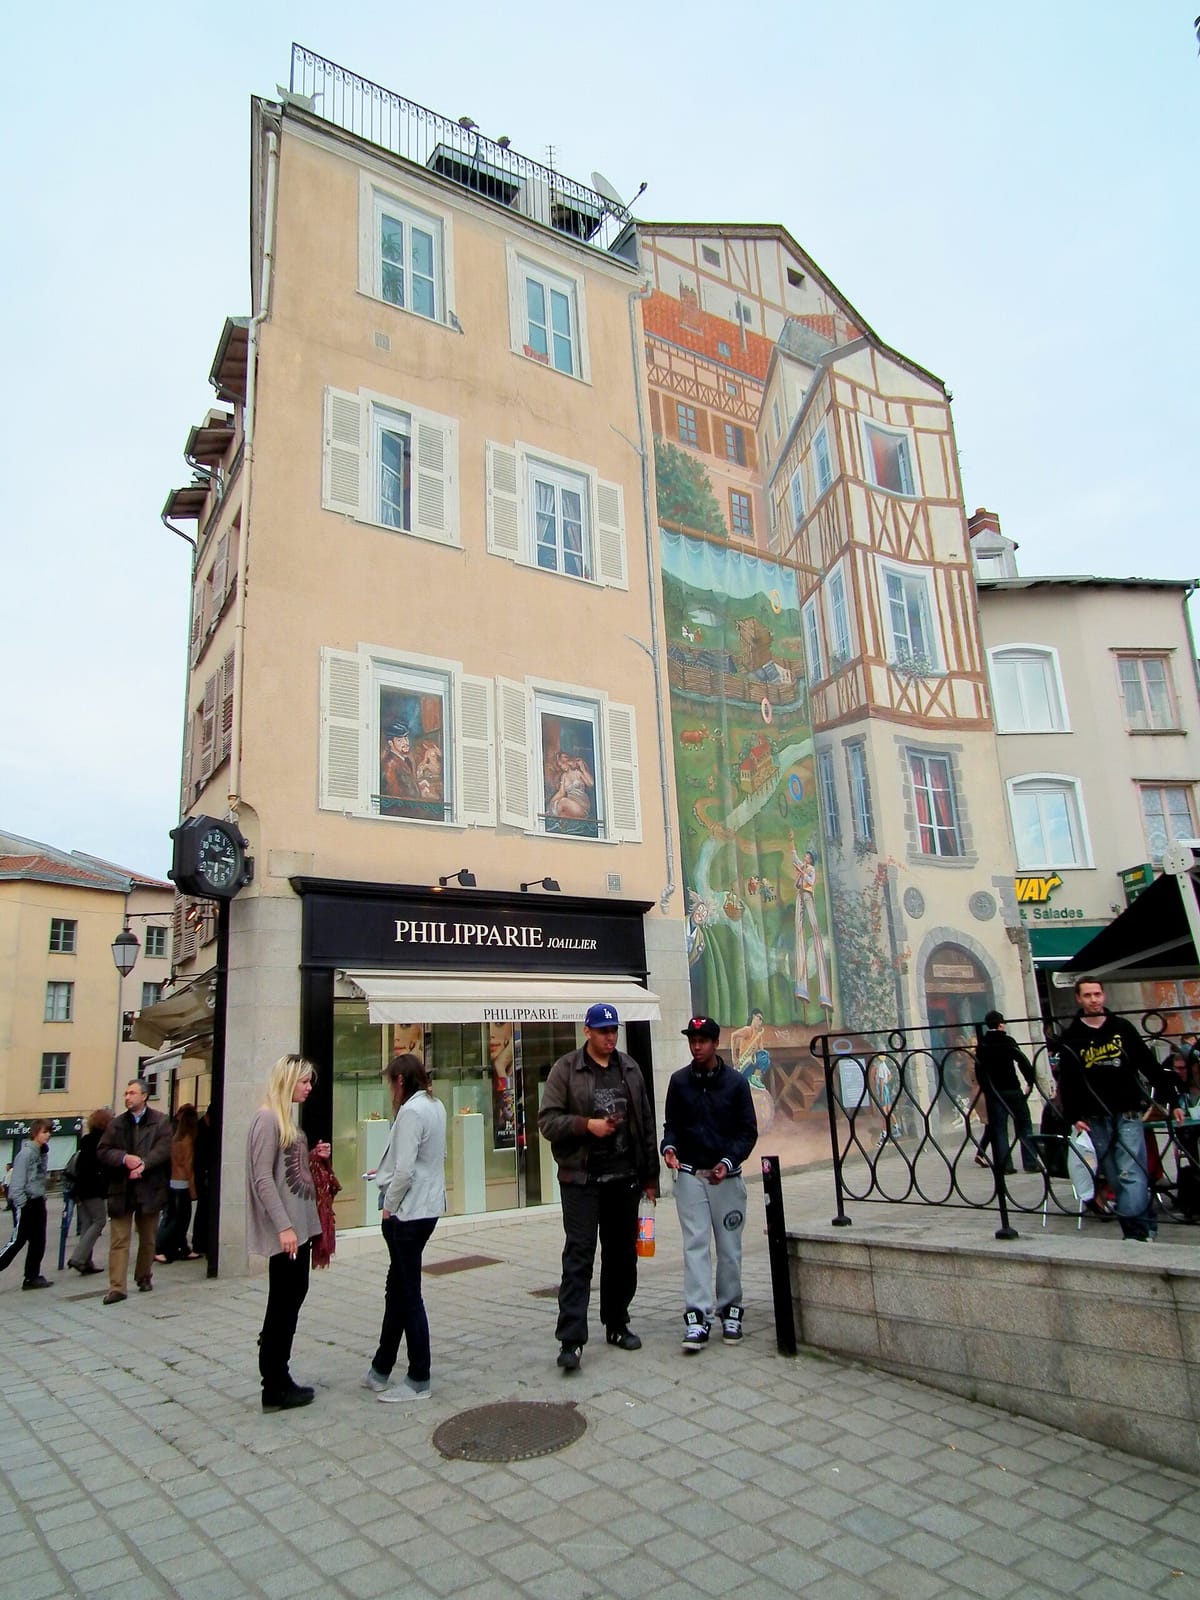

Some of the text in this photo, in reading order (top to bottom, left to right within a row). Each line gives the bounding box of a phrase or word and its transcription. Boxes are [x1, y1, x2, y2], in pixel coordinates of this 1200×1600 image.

[214, 833, 221, 842] 12
[1033, 907, 1084, 920] Salades
[394, 920, 597, 950] PHILIPPARIE JOAILLIER
[484, 1008, 559, 1020] PHILIPPARIE
[6, 1127, 21, 1135] THE
